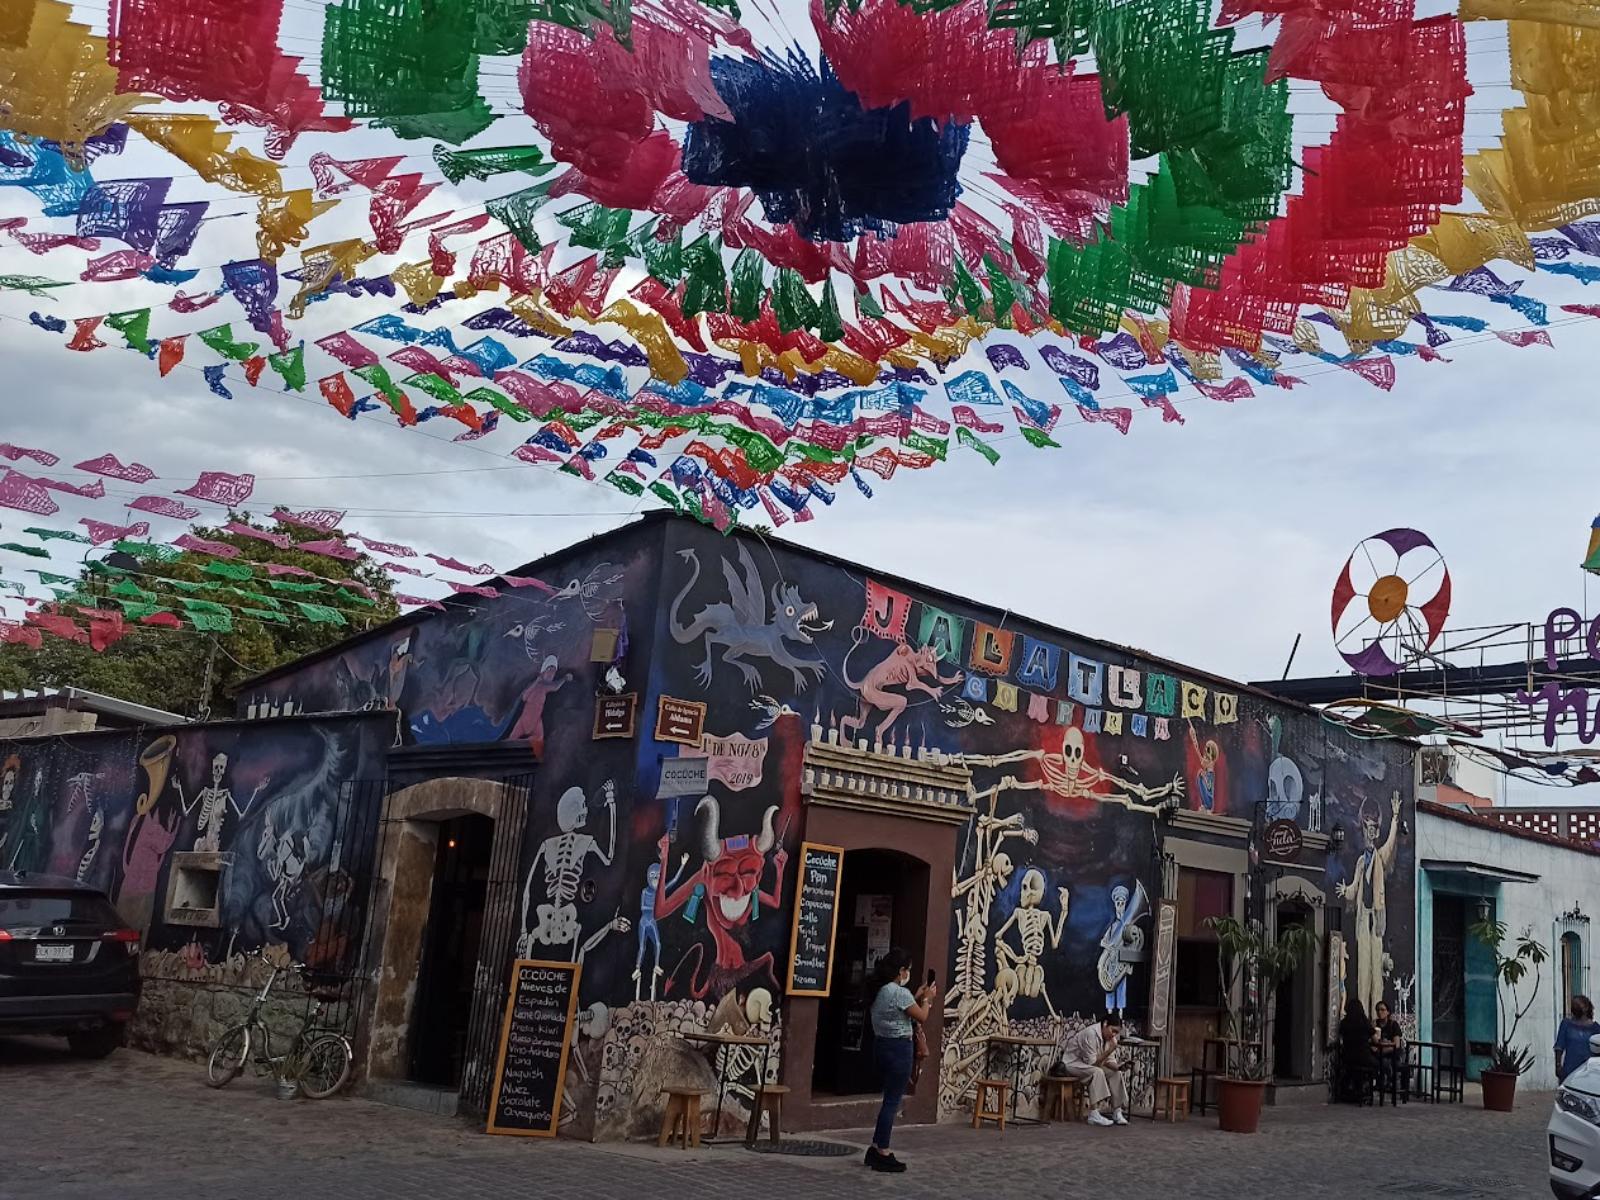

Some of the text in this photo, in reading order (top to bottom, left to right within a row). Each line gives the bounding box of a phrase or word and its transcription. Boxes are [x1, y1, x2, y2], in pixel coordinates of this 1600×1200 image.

[873, 595, 1232, 720] JALATLACO
[810, 869, 828, 884] Pan
[521, 982, 567, 994] Nieves de
[508, 1055, 532, 1066] Tuna
[503, 1082, 530, 1095] Nuez
